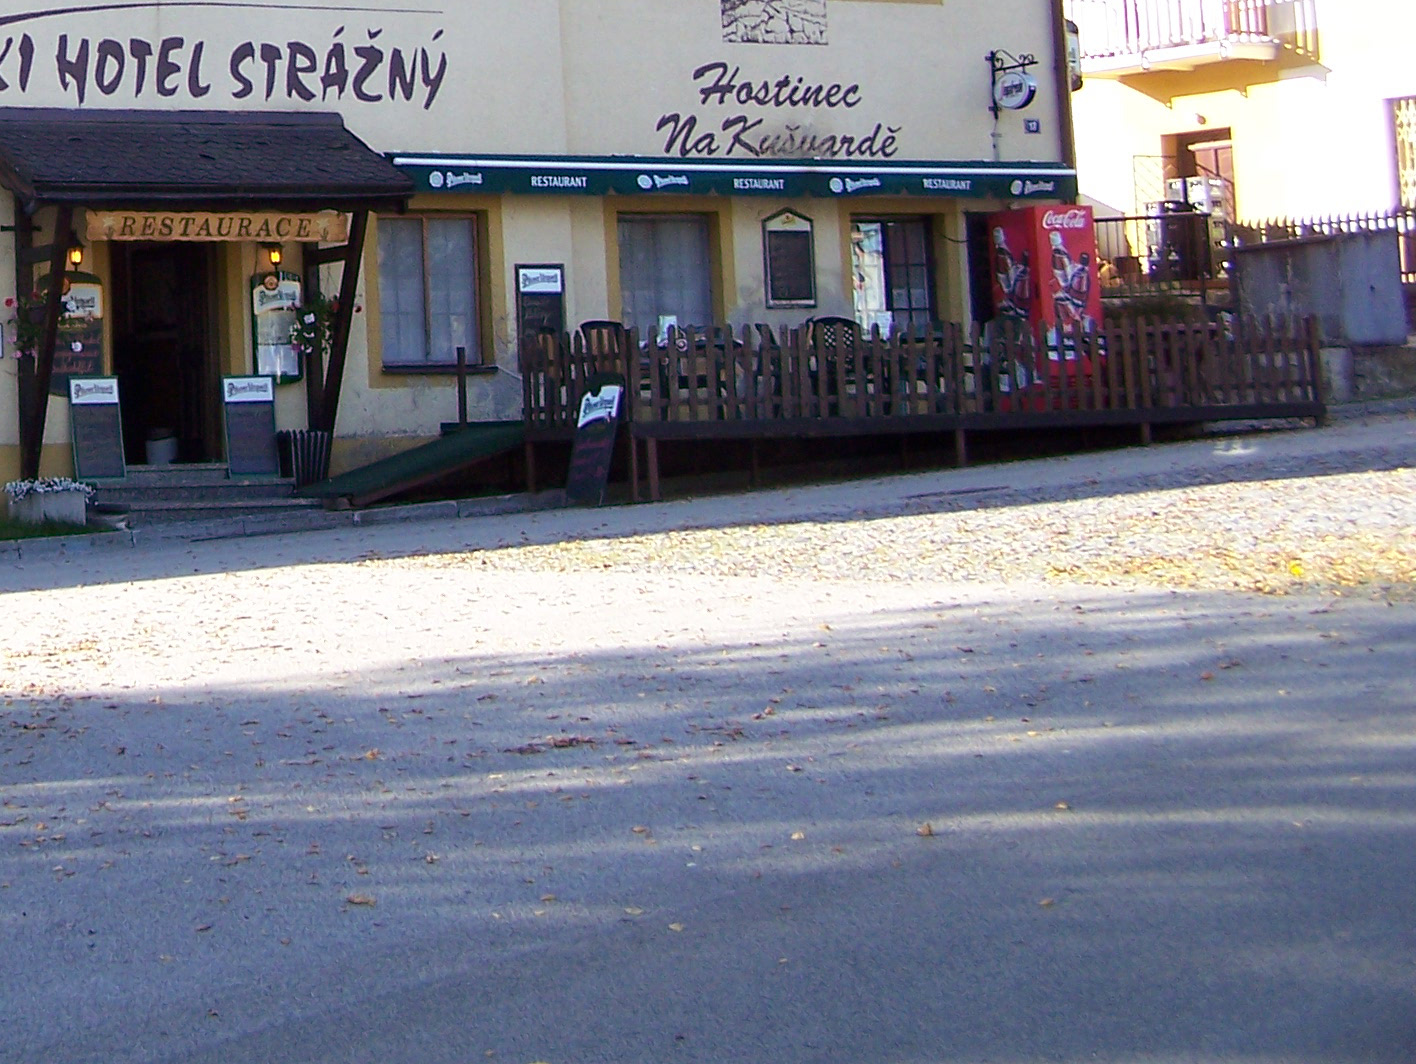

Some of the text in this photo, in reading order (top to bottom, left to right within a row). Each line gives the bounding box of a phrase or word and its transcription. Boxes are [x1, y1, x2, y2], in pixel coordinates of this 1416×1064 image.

[54, 32, 212, 107] HOTEL
[229, 25, 449, 111] STRÁŽNÝ
[691, 61, 862, 109] Hostinec
[655, 112, 721, 157] Na
[530, 175, 587, 188] RESTAURANT
[733, 178, 785, 190] RESTAURANT
[922, 178, 972, 190] RESTAURANT
[119, 215, 313, 238] RESTAURACE
[1041, 209, 1087, 229] Coca-Cola
